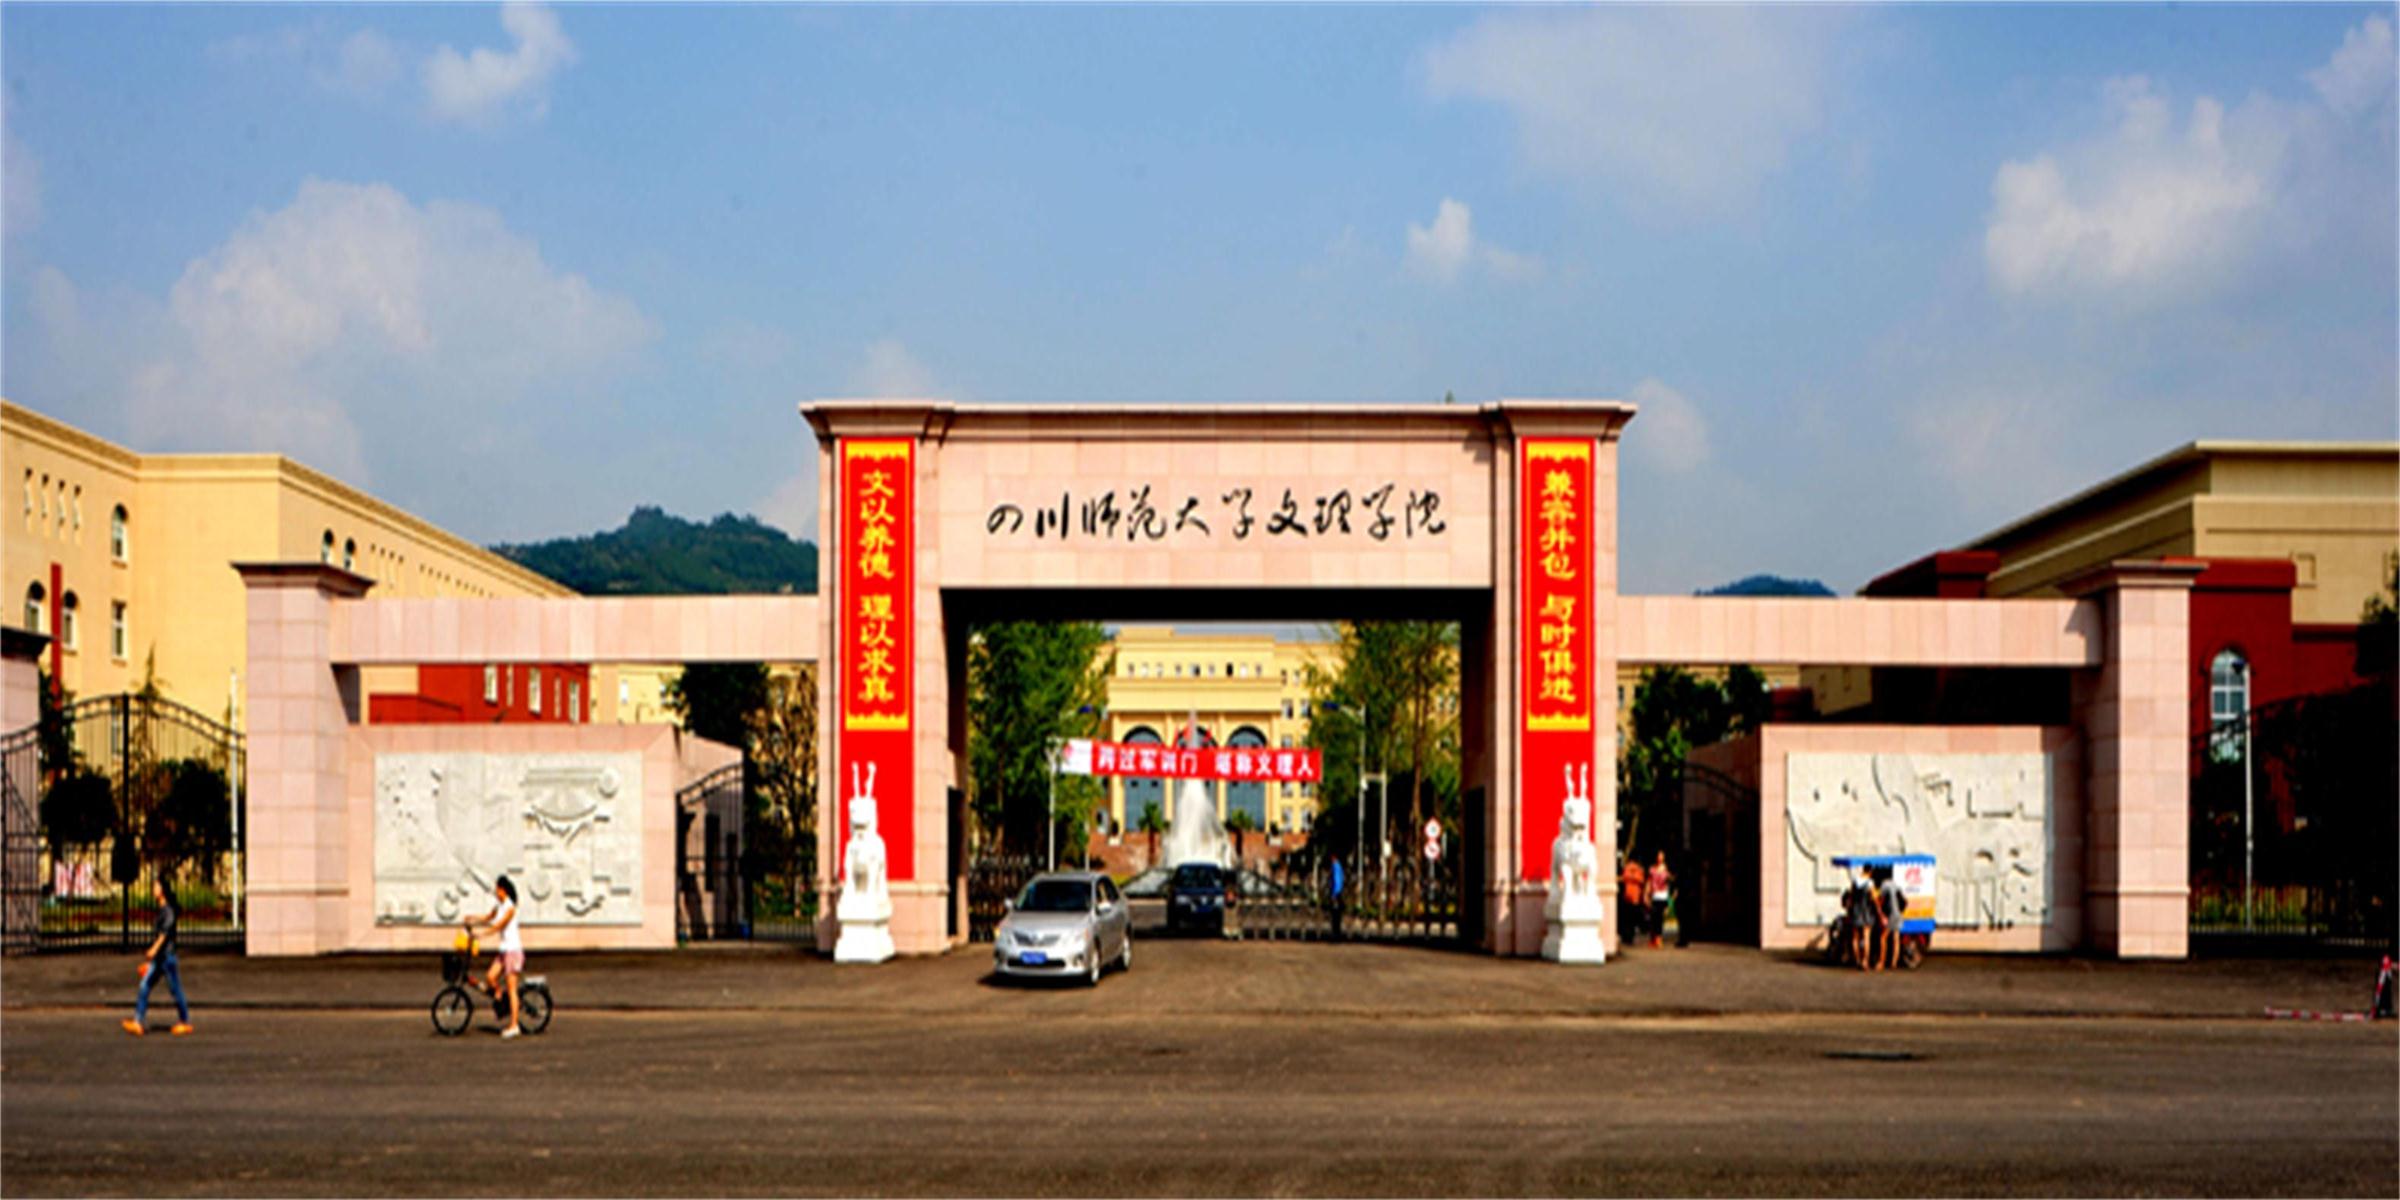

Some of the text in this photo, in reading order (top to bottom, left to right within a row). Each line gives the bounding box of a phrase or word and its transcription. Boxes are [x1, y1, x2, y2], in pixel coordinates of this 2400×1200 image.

[858, 468, 896, 703] 文以养德 理以求真
[986, 484, 1446, 541] 四川师范大学文理学院
